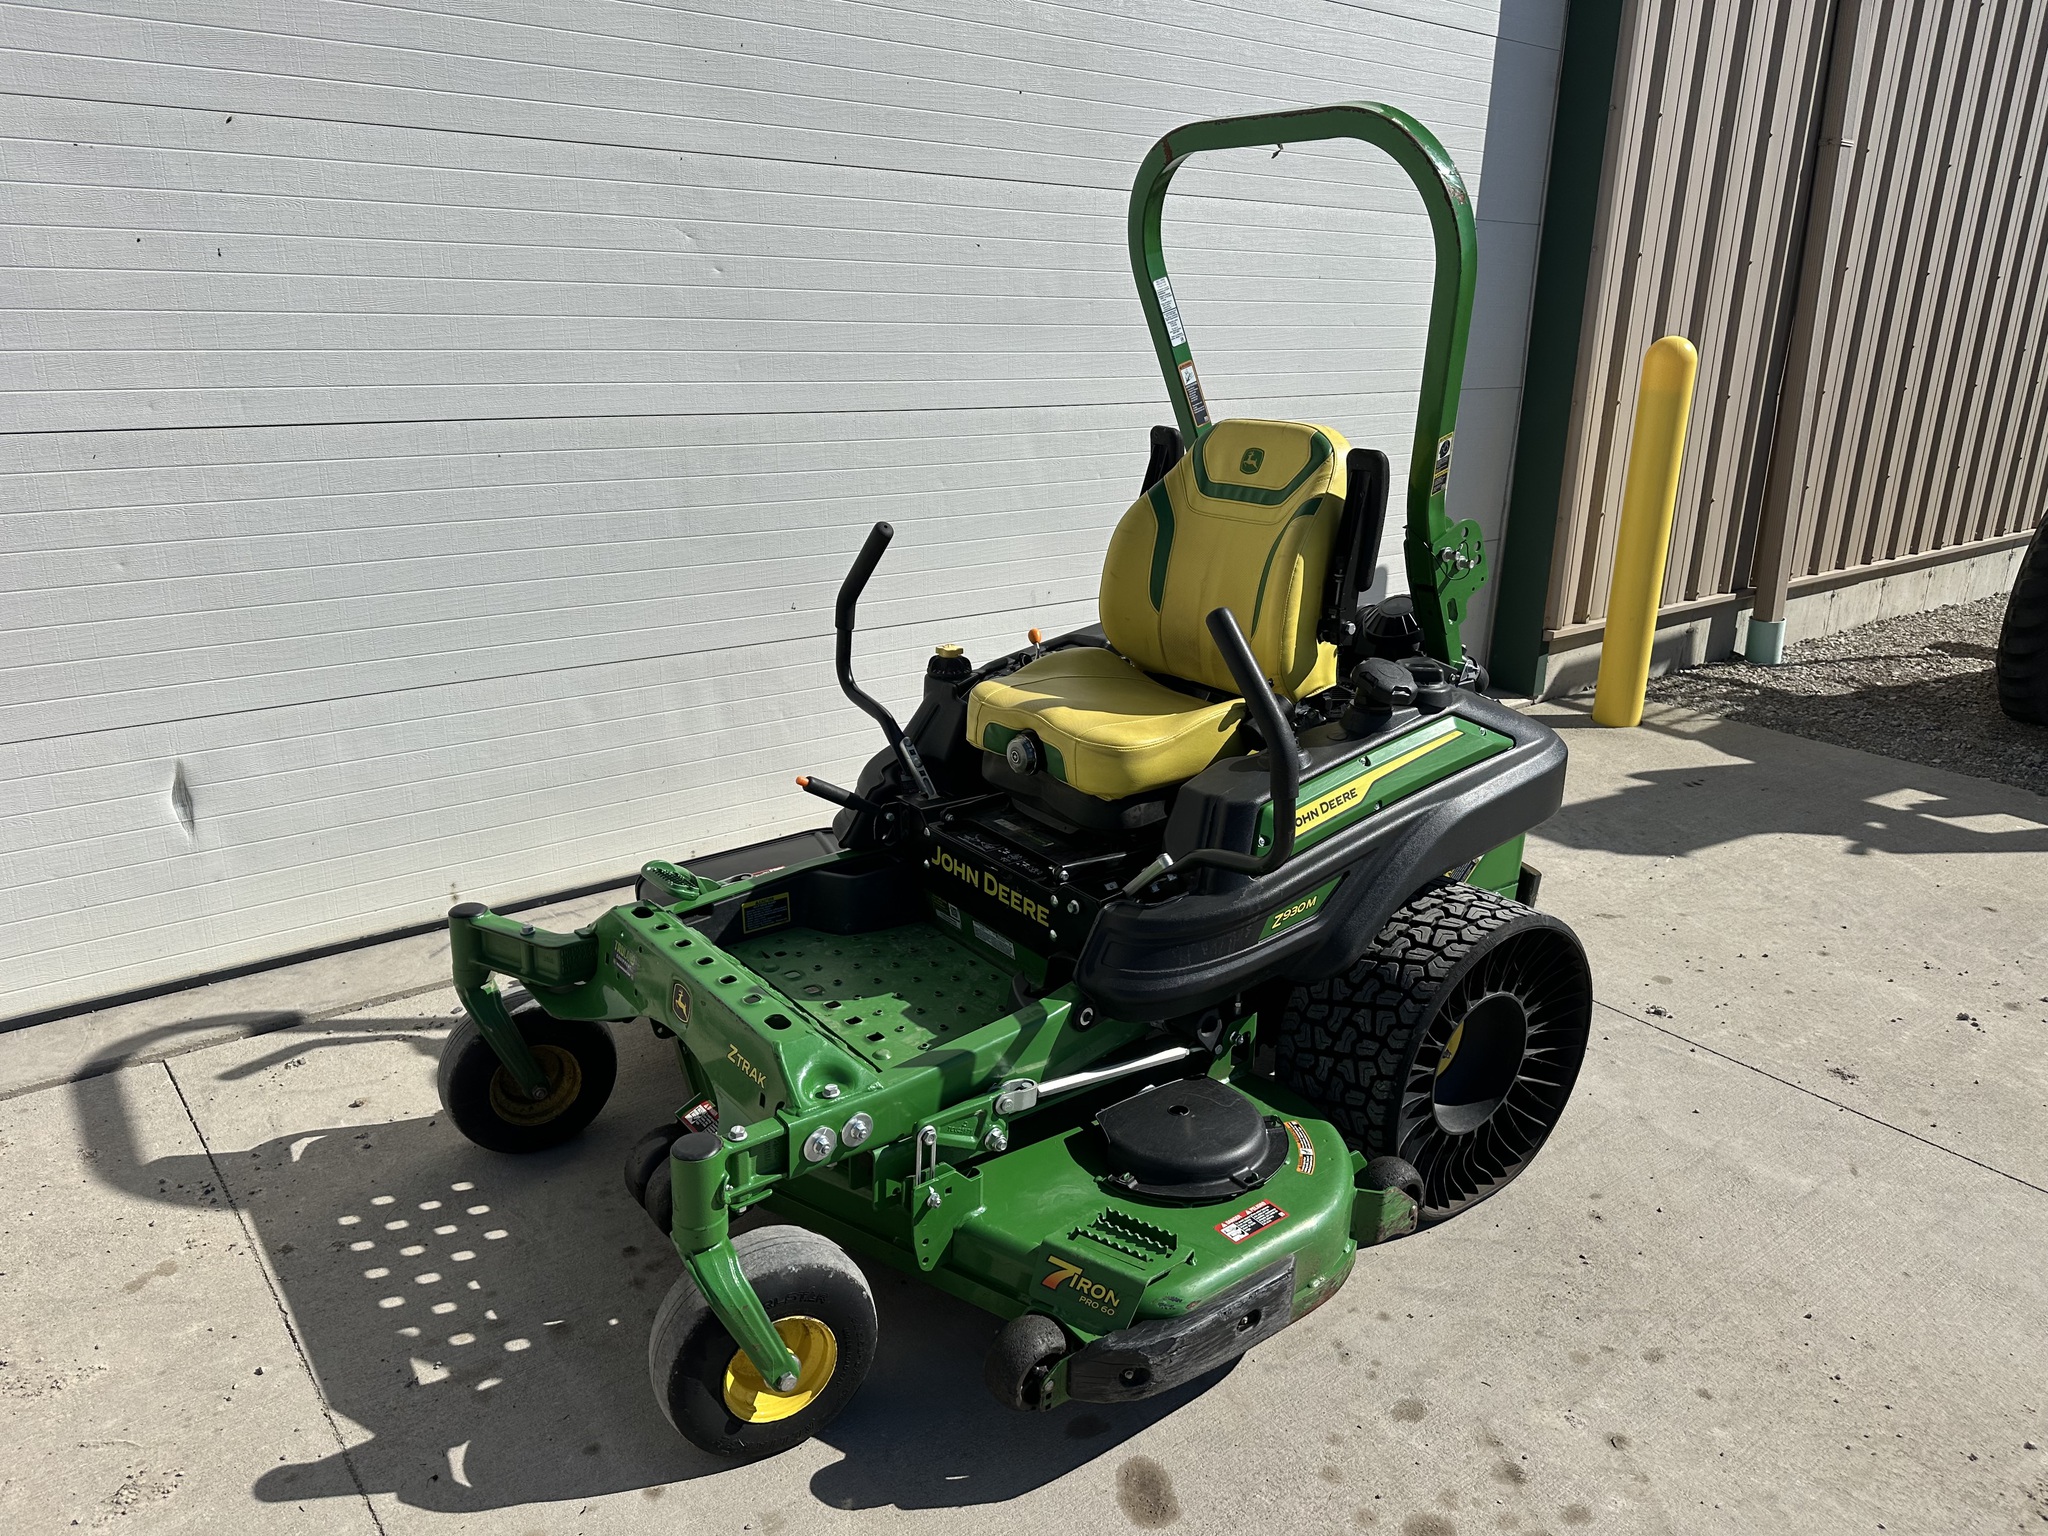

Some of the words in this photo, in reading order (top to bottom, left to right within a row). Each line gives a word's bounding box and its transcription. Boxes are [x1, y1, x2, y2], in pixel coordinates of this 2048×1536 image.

[1295, 808, 1319, 827] OHN
[1319, 788, 1358, 814] DEERE
[931, 845, 979, 888] JOHN
[984, 871, 1050, 928] DEERE
[1271, 896, 1318, 929] Z930M
[727, 1043, 767, 1089] ZTRAK
[1079, 1295, 1099, 1309] PRO
[1100, 1305, 1115, 1316] 60
